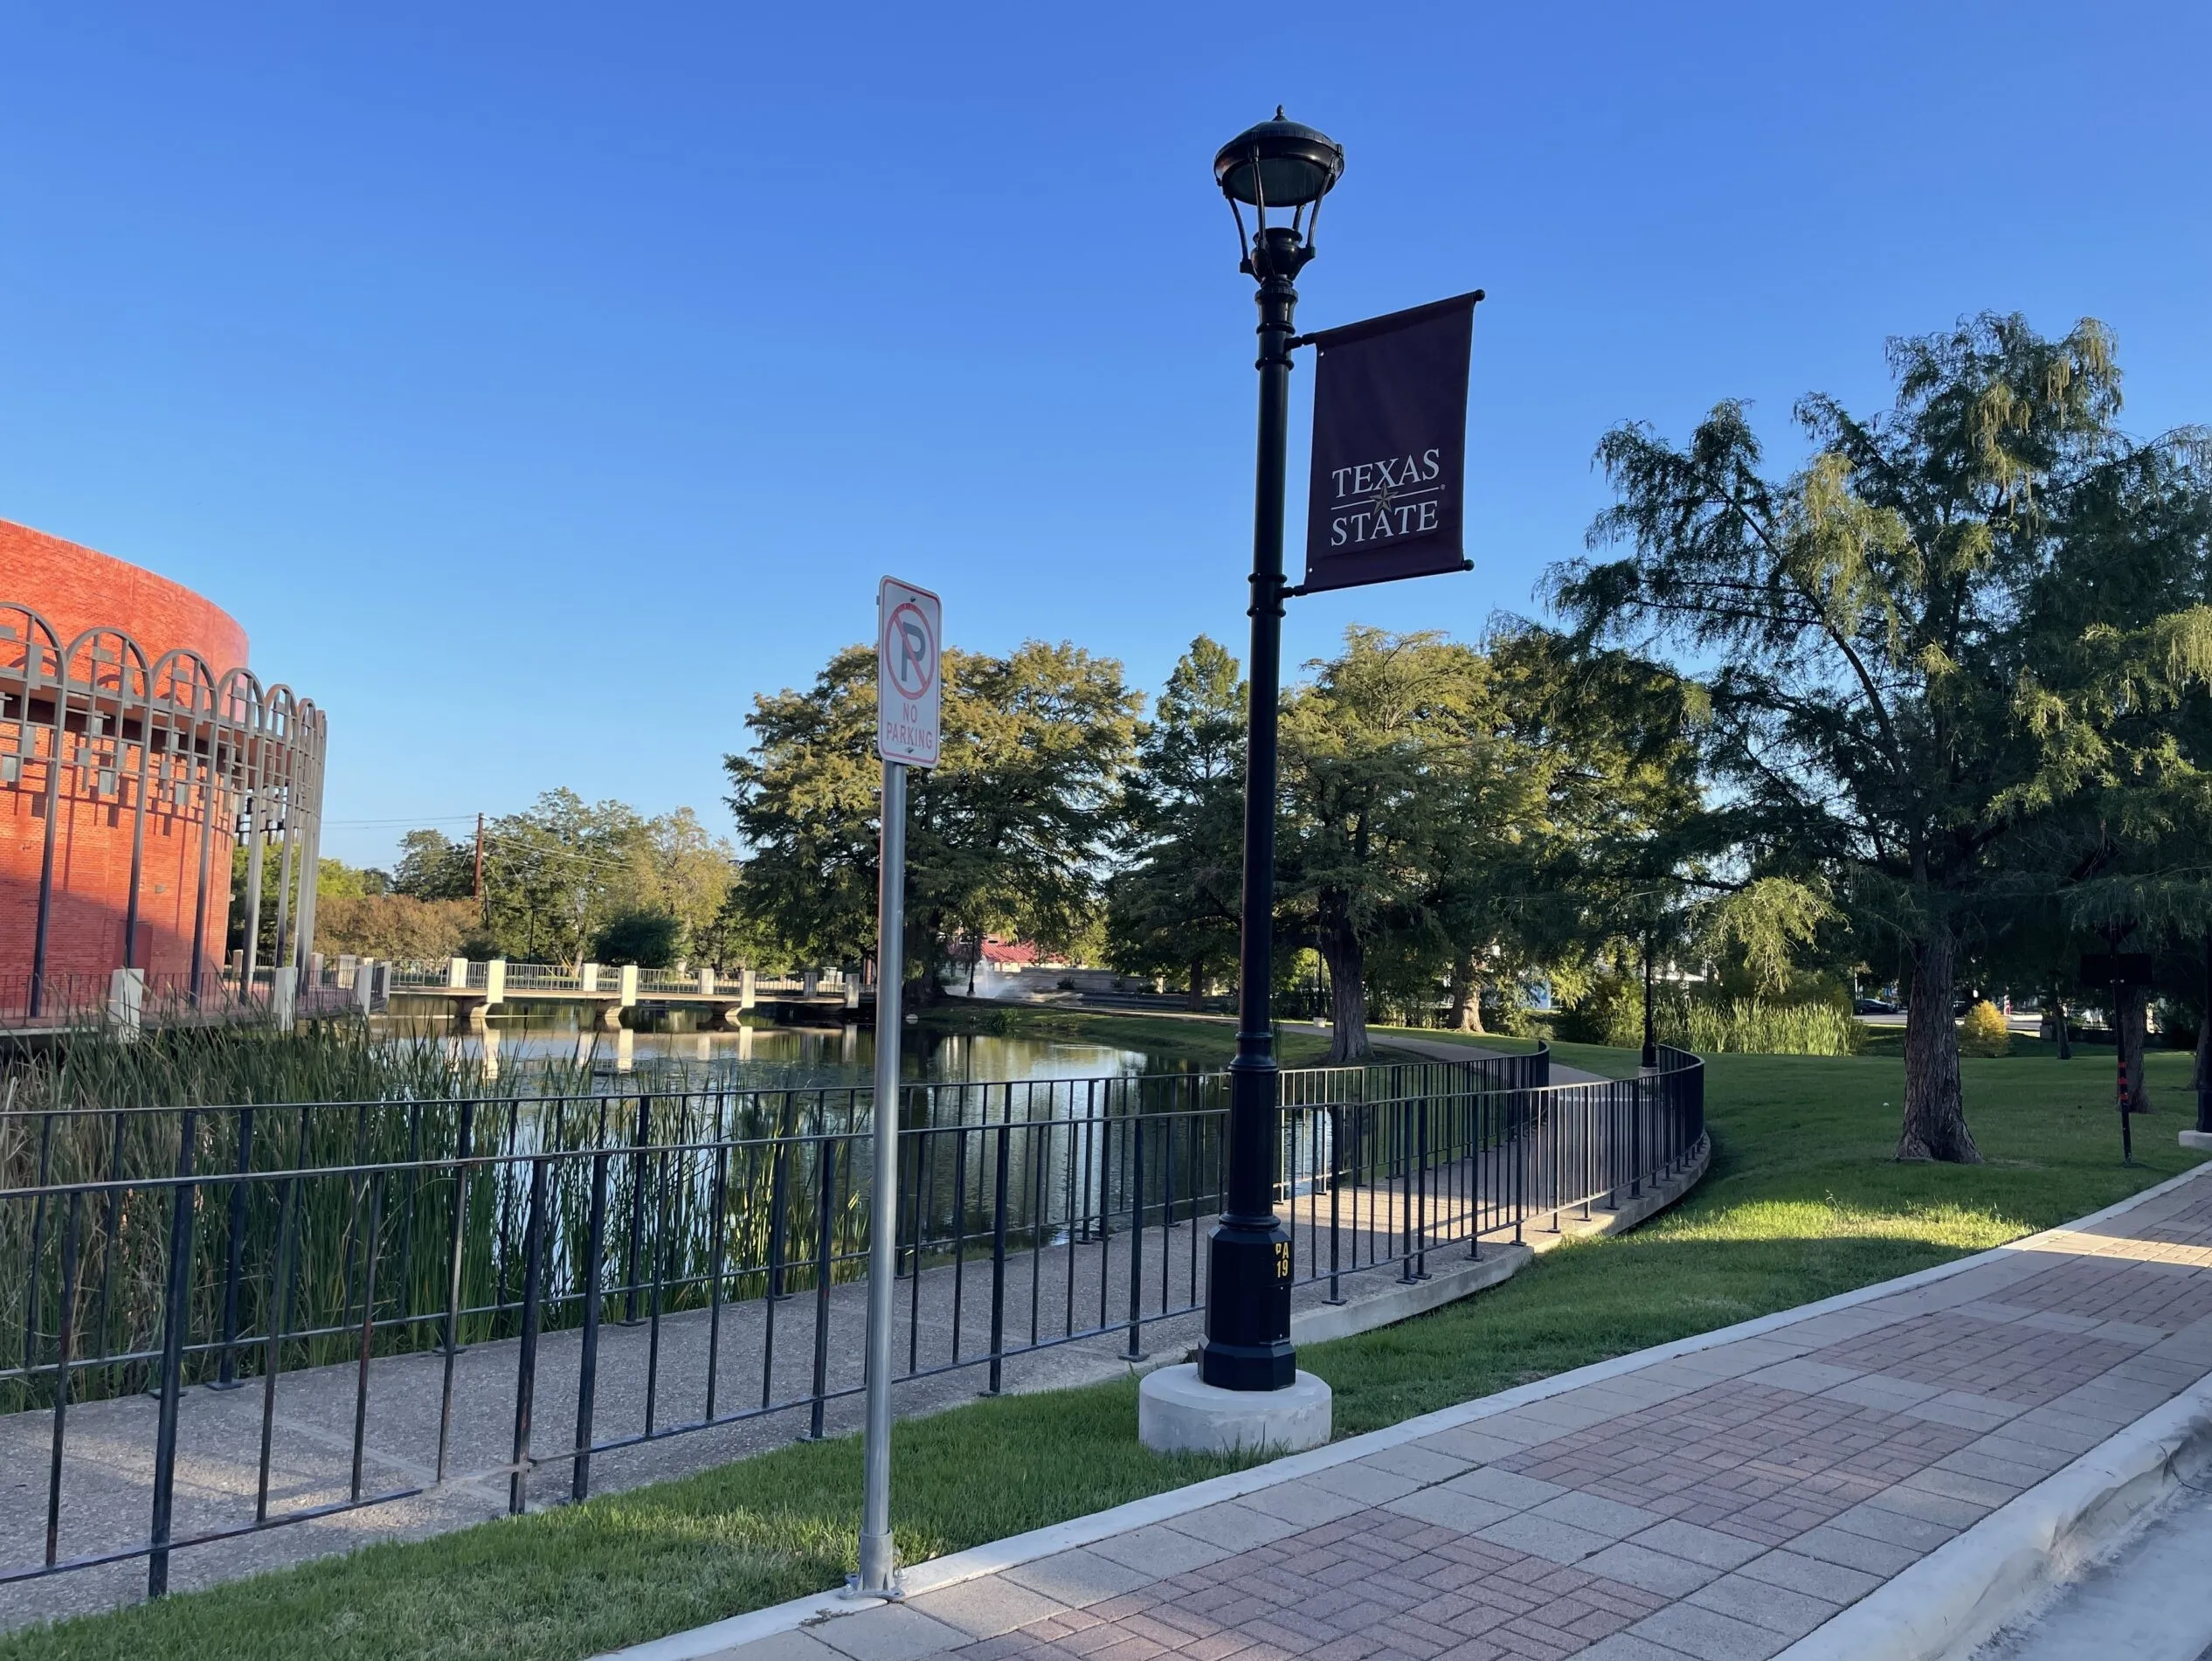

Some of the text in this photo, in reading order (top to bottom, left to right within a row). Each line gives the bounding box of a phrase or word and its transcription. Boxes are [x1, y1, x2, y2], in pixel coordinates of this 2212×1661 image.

[1331, 448, 1440, 498] TEXAS
[1331, 500, 1439, 546] STATE
[902, 702, 917, 723] NO
[887, 722, 932, 750] PARKING
[1276, 1259, 1289, 1278] 19
